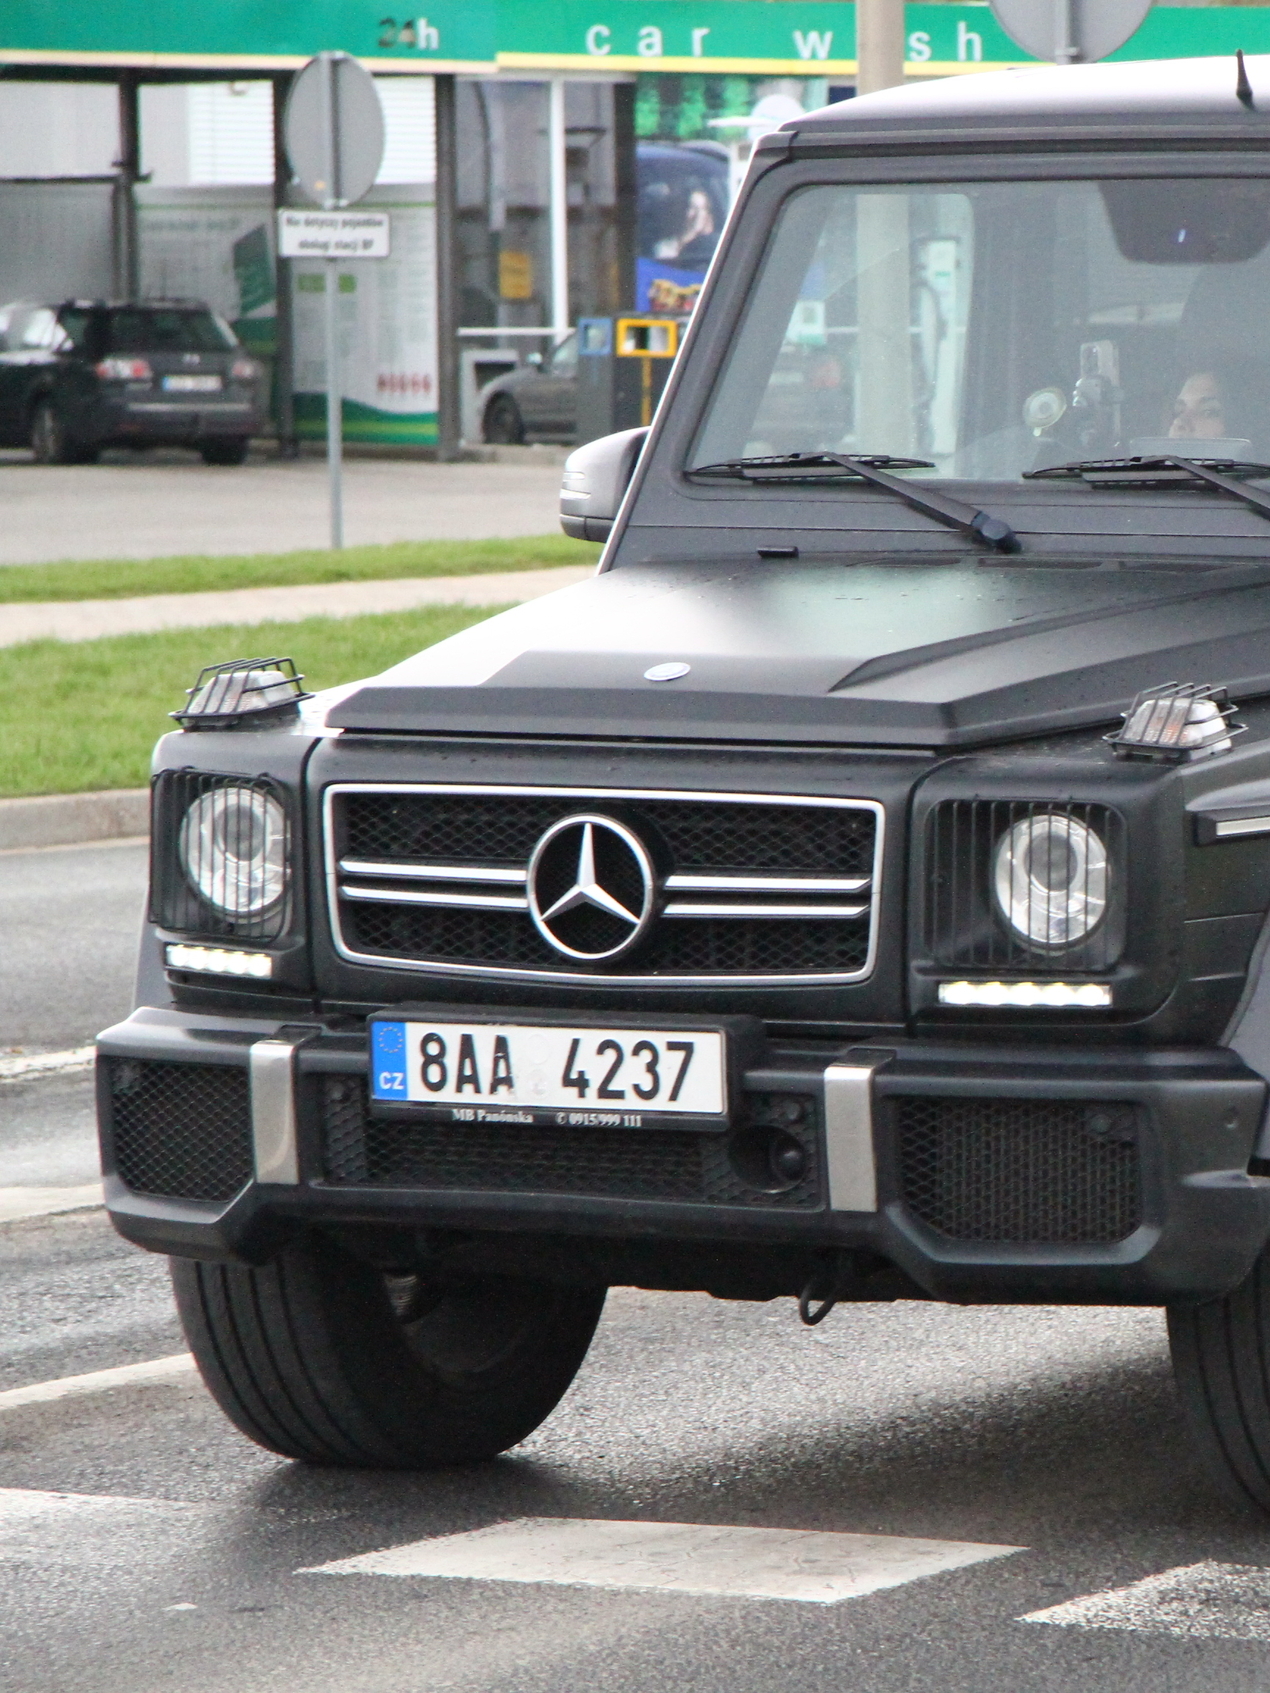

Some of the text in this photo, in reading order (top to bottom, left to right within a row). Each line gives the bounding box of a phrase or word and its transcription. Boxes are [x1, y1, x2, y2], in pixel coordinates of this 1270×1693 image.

[585, 21, 983, 62] car wsh
[379, 1072, 405, 1090] CZ
[419, 1032, 695, 1102] 8AA 4237
[452, 1108, 475, 1121] MB
